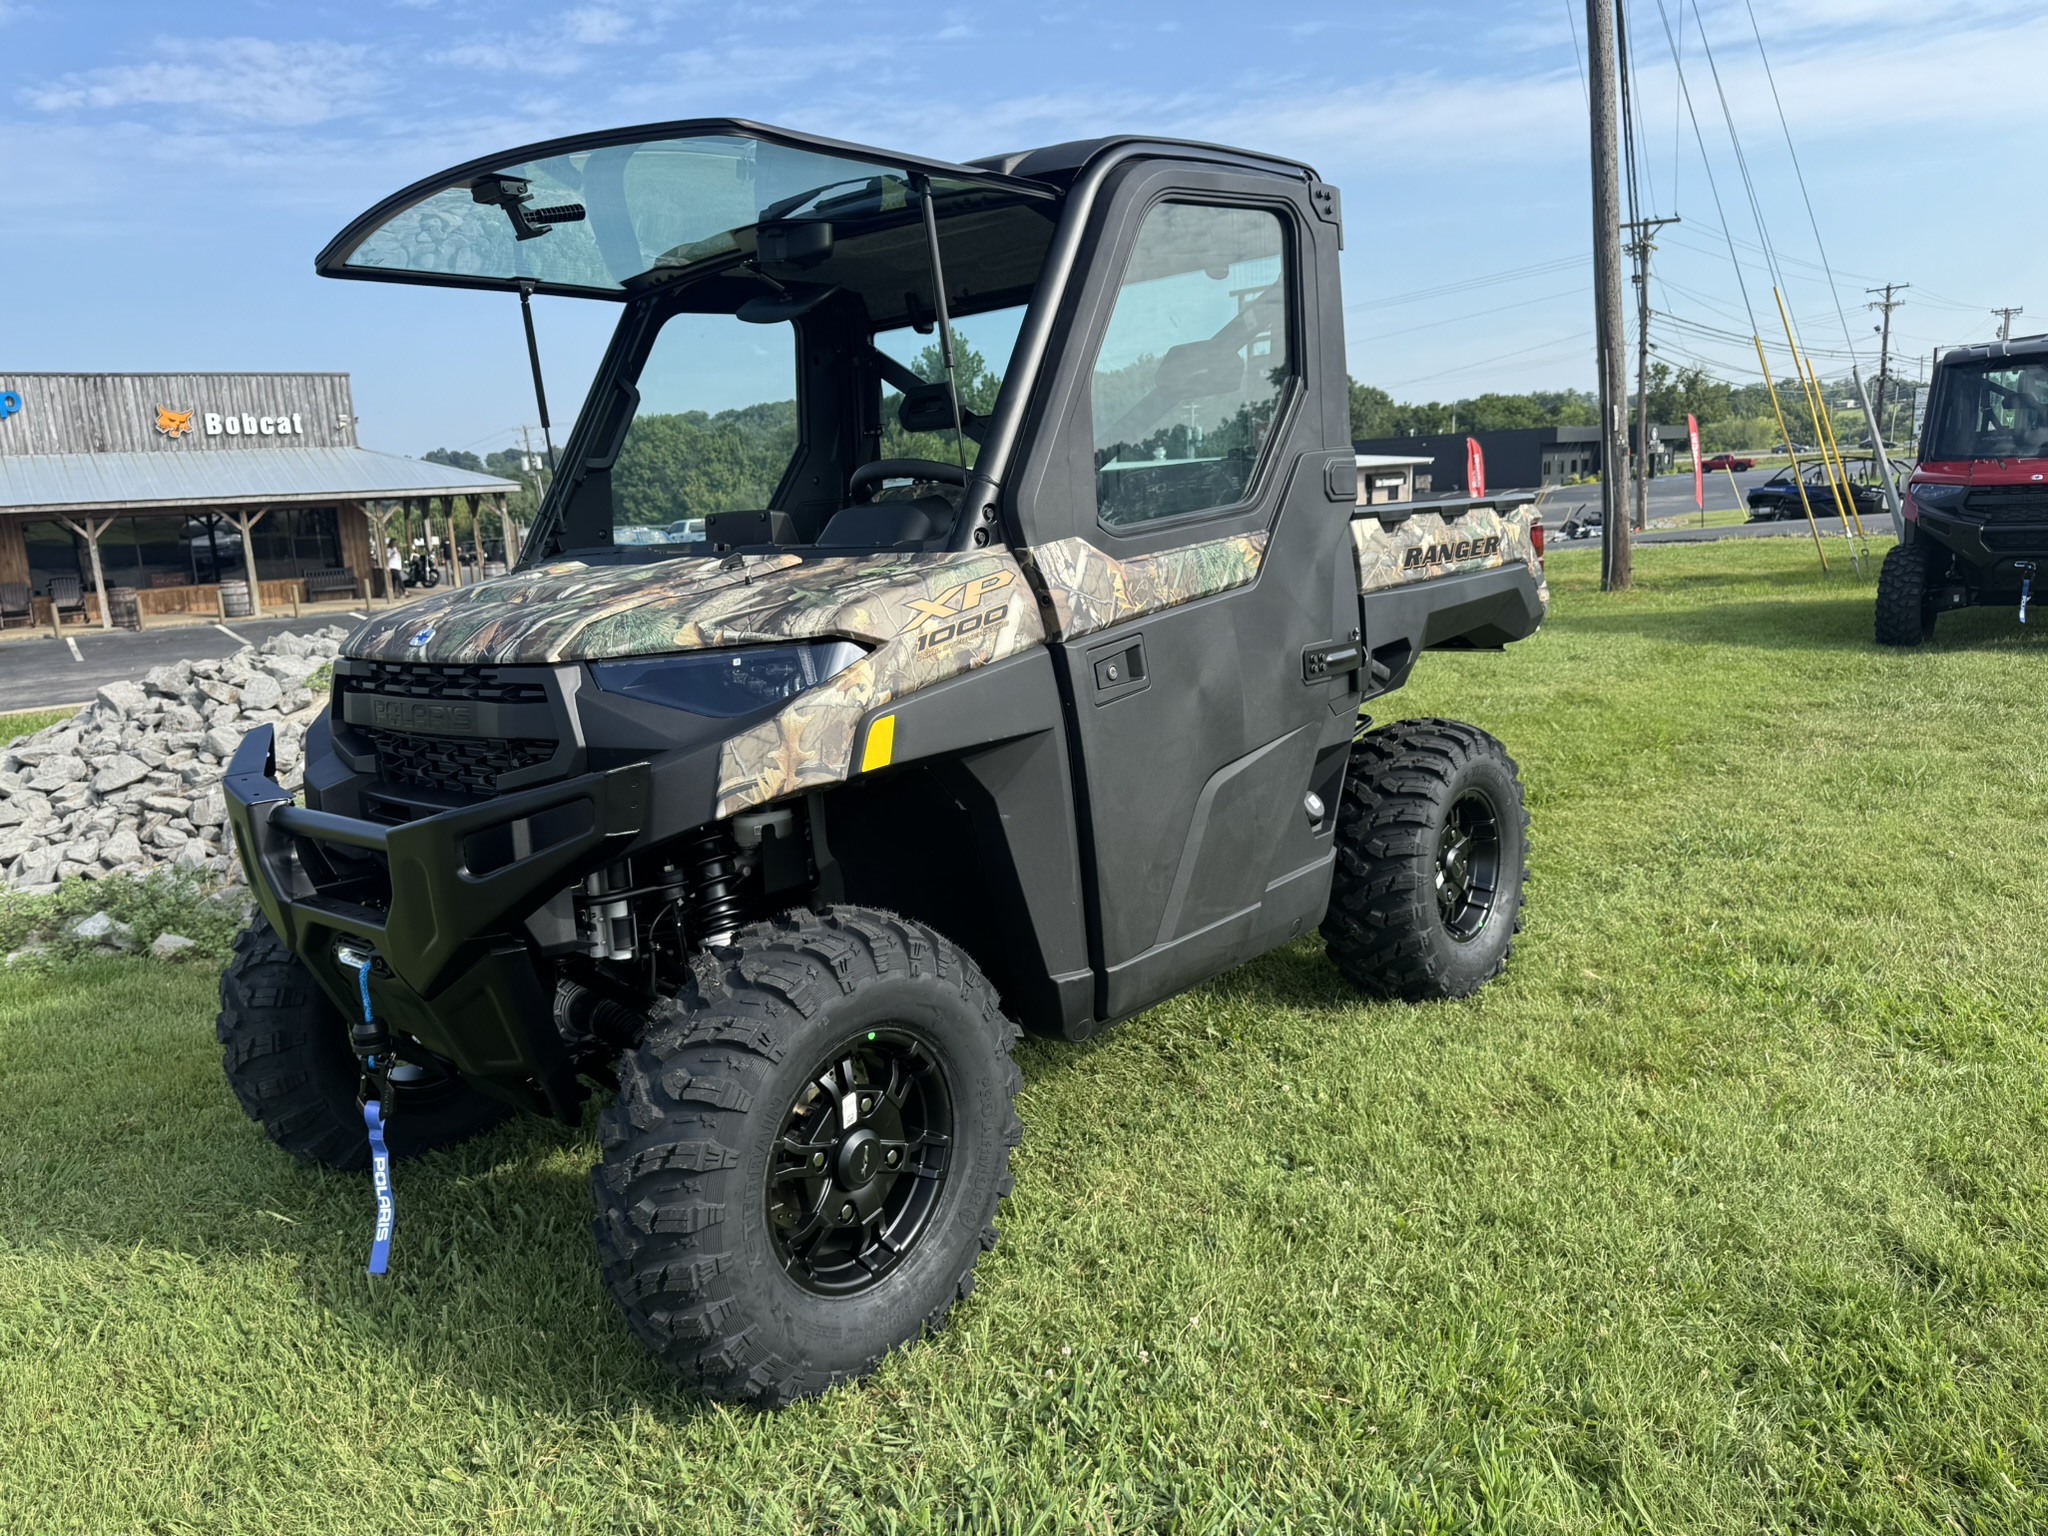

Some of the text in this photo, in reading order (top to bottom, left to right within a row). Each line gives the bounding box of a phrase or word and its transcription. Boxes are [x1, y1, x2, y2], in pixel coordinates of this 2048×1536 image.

[204, 412, 303, 435] Bobcat
[1403, 535, 1499, 569] RANGER
[898, 569, 1016, 635] XP
[916, 604, 1009, 652] 1000
[373, 700, 472, 731] POLARIS
[374, 1157, 391, 1241] POLARIS
[742, 1097, 784, 1278] X-TERRAIN
